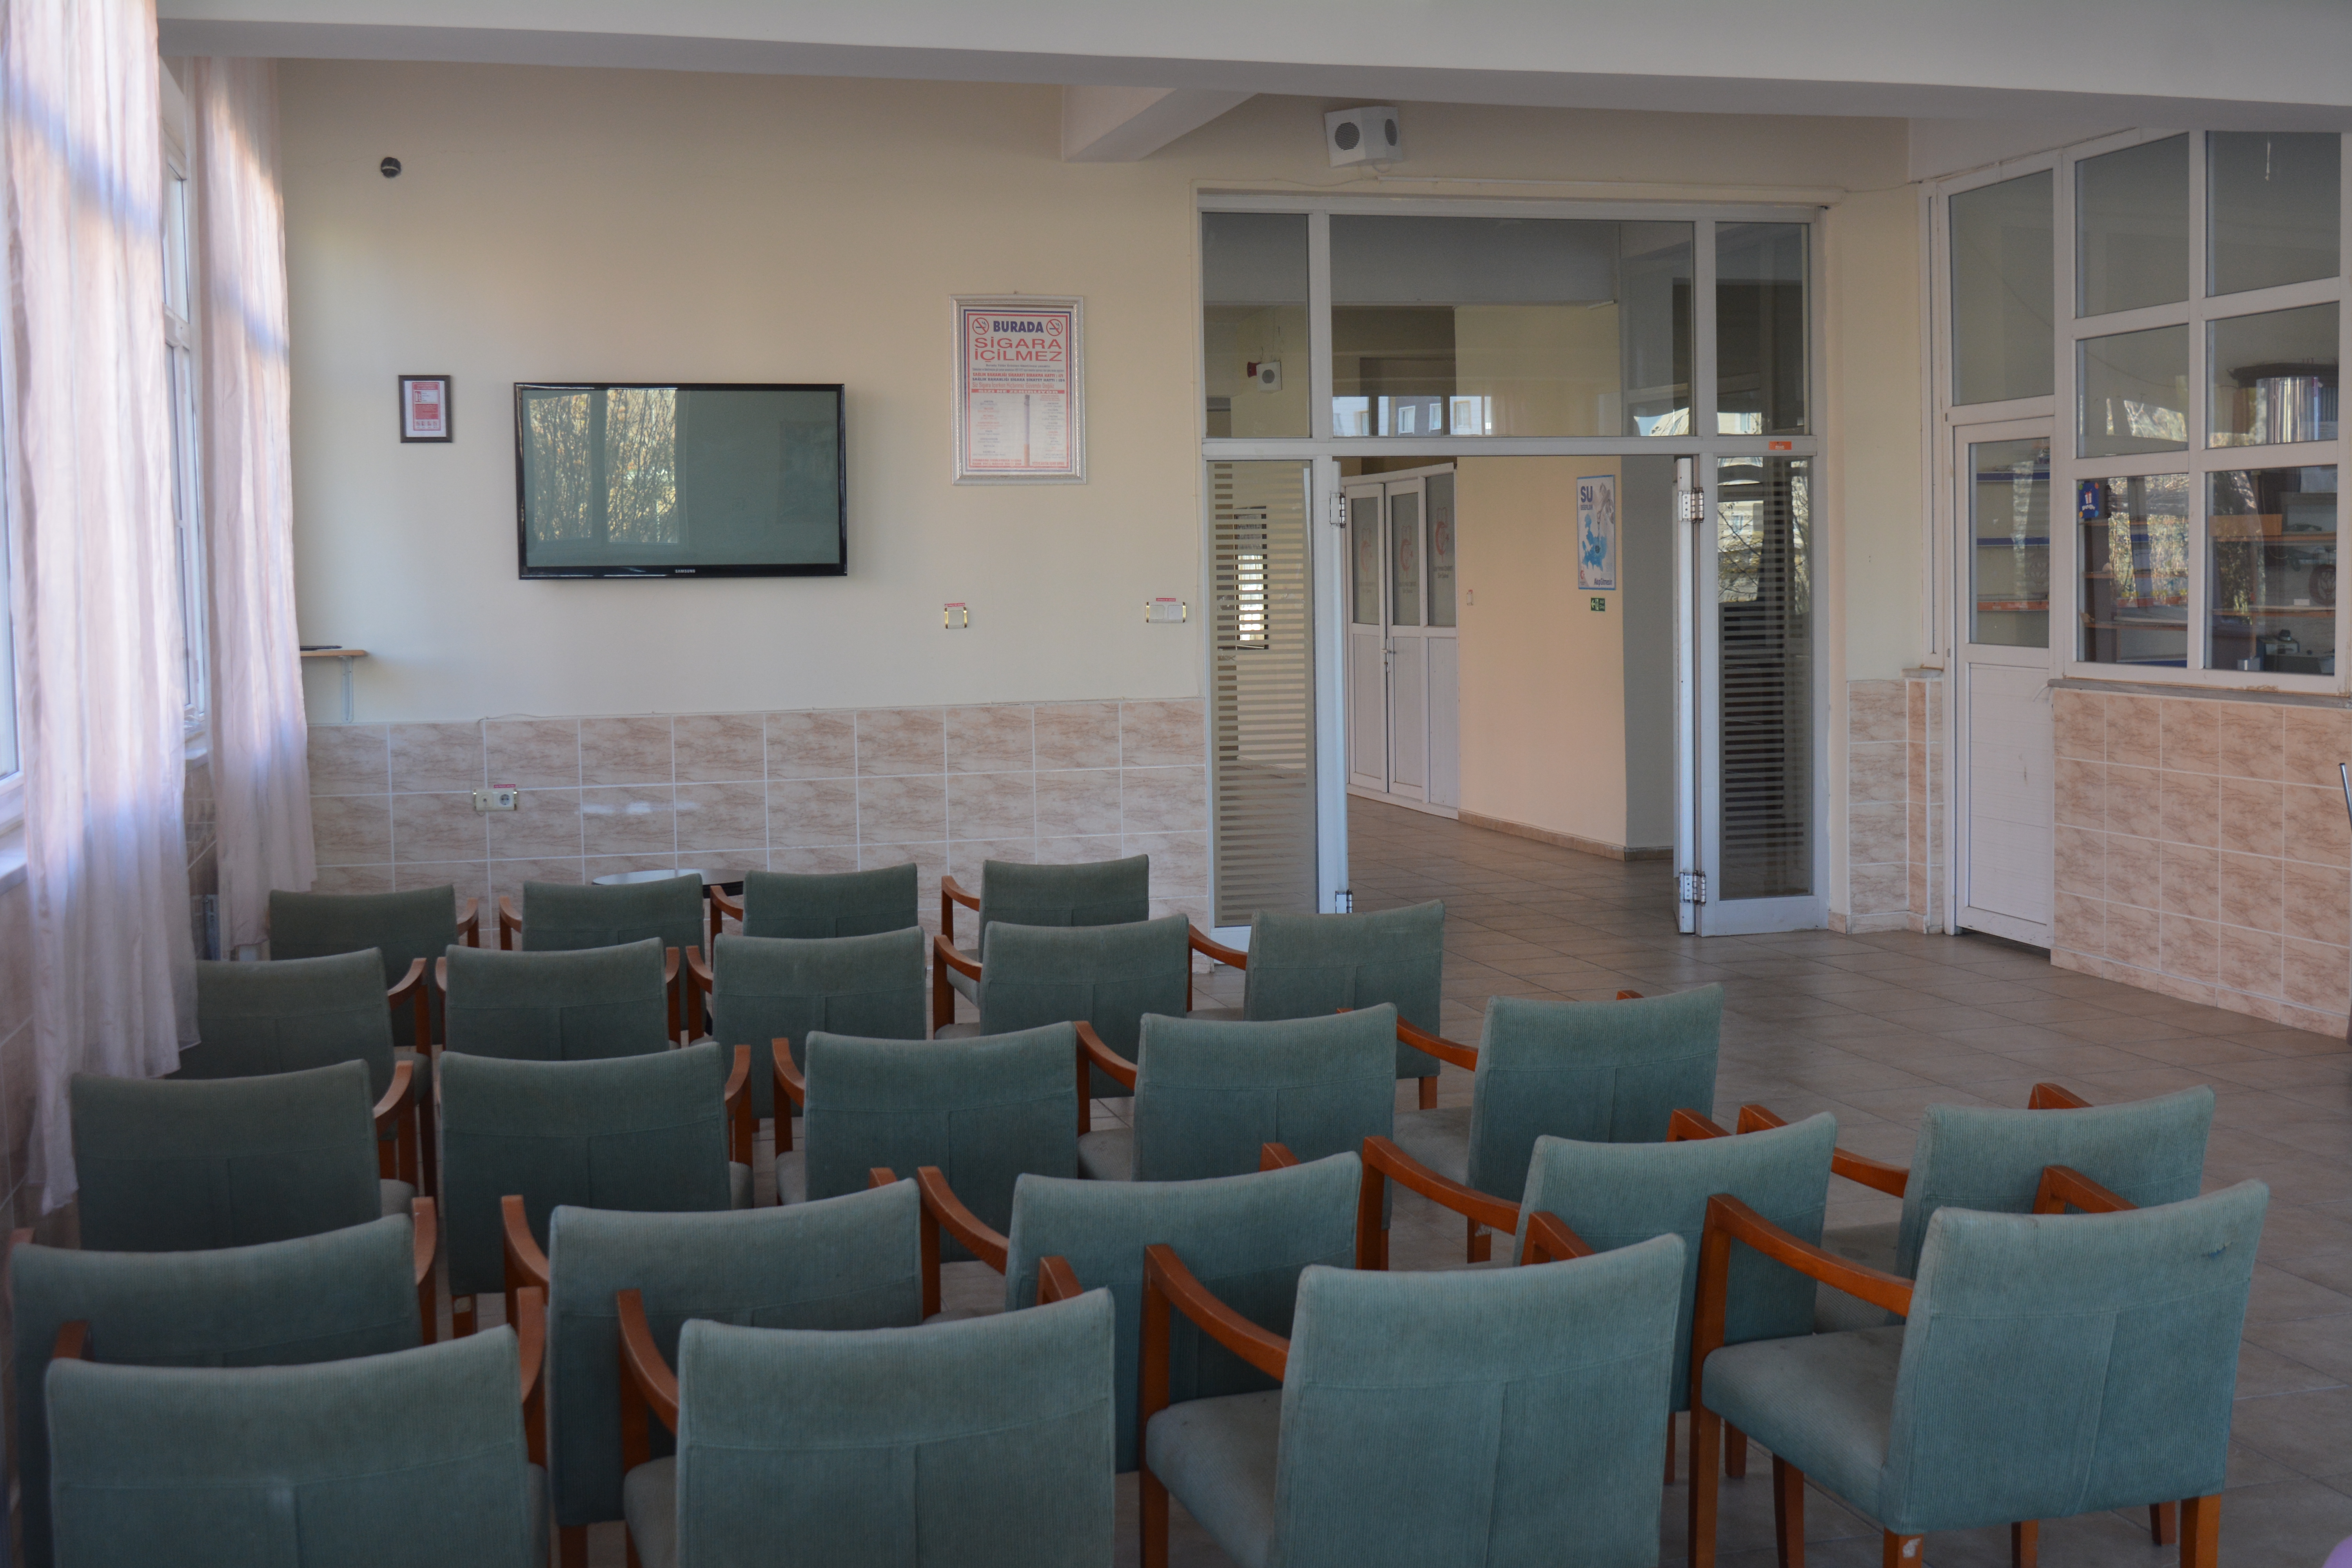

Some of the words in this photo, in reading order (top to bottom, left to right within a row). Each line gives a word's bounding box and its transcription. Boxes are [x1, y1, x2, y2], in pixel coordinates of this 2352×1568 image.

[993, 321, 1044, 333] BURADA
[975, 337, 1062, 349] SİGARA
[975, 348, 1062, 362] İÇİLMEZ
[1581, 486, 1593, 503] SU
